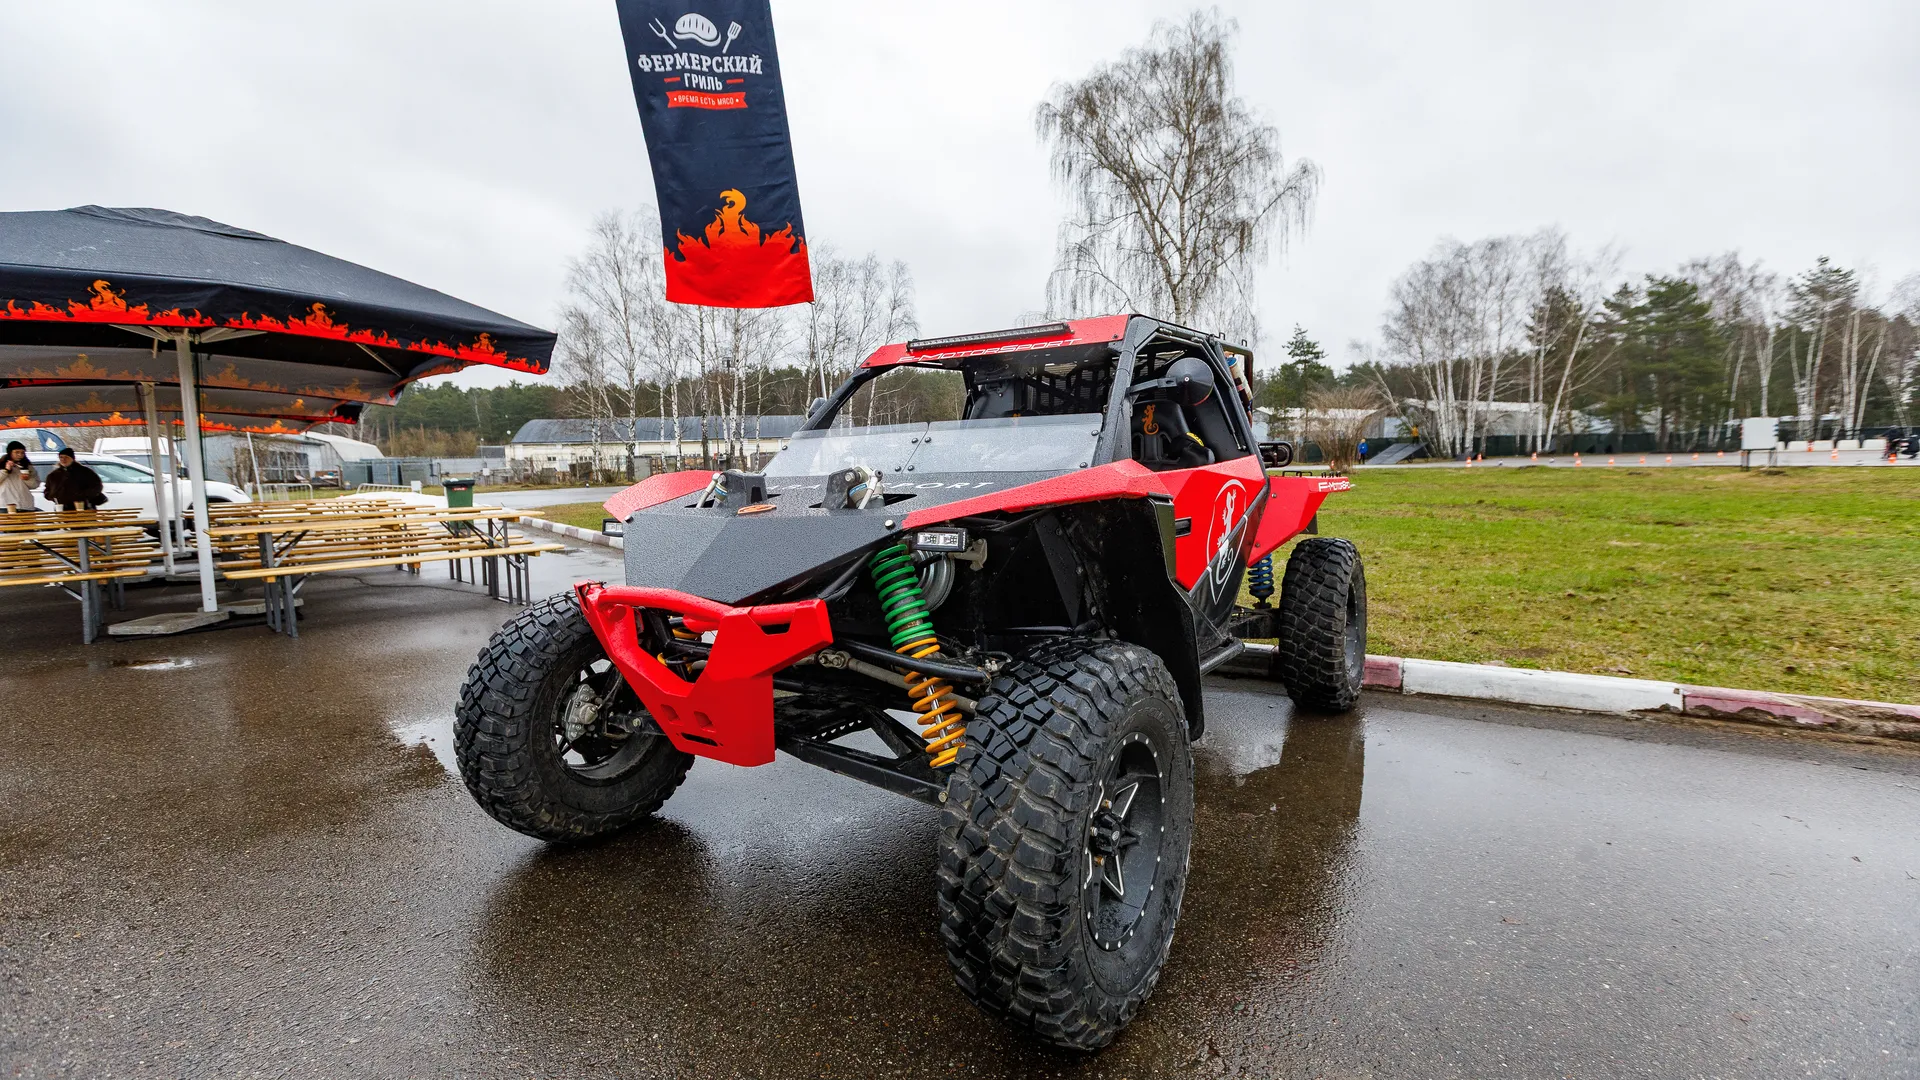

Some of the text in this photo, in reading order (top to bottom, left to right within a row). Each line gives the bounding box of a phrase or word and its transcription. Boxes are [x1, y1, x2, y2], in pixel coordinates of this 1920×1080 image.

[638, 52, 763, 75] ФЕРМЕРСКИЙ
[683, 73, 723, 91] ГРИЛЬ
[677, 95, 734, 106] ВРЕМЯ ЕСТЬ МЯСО
